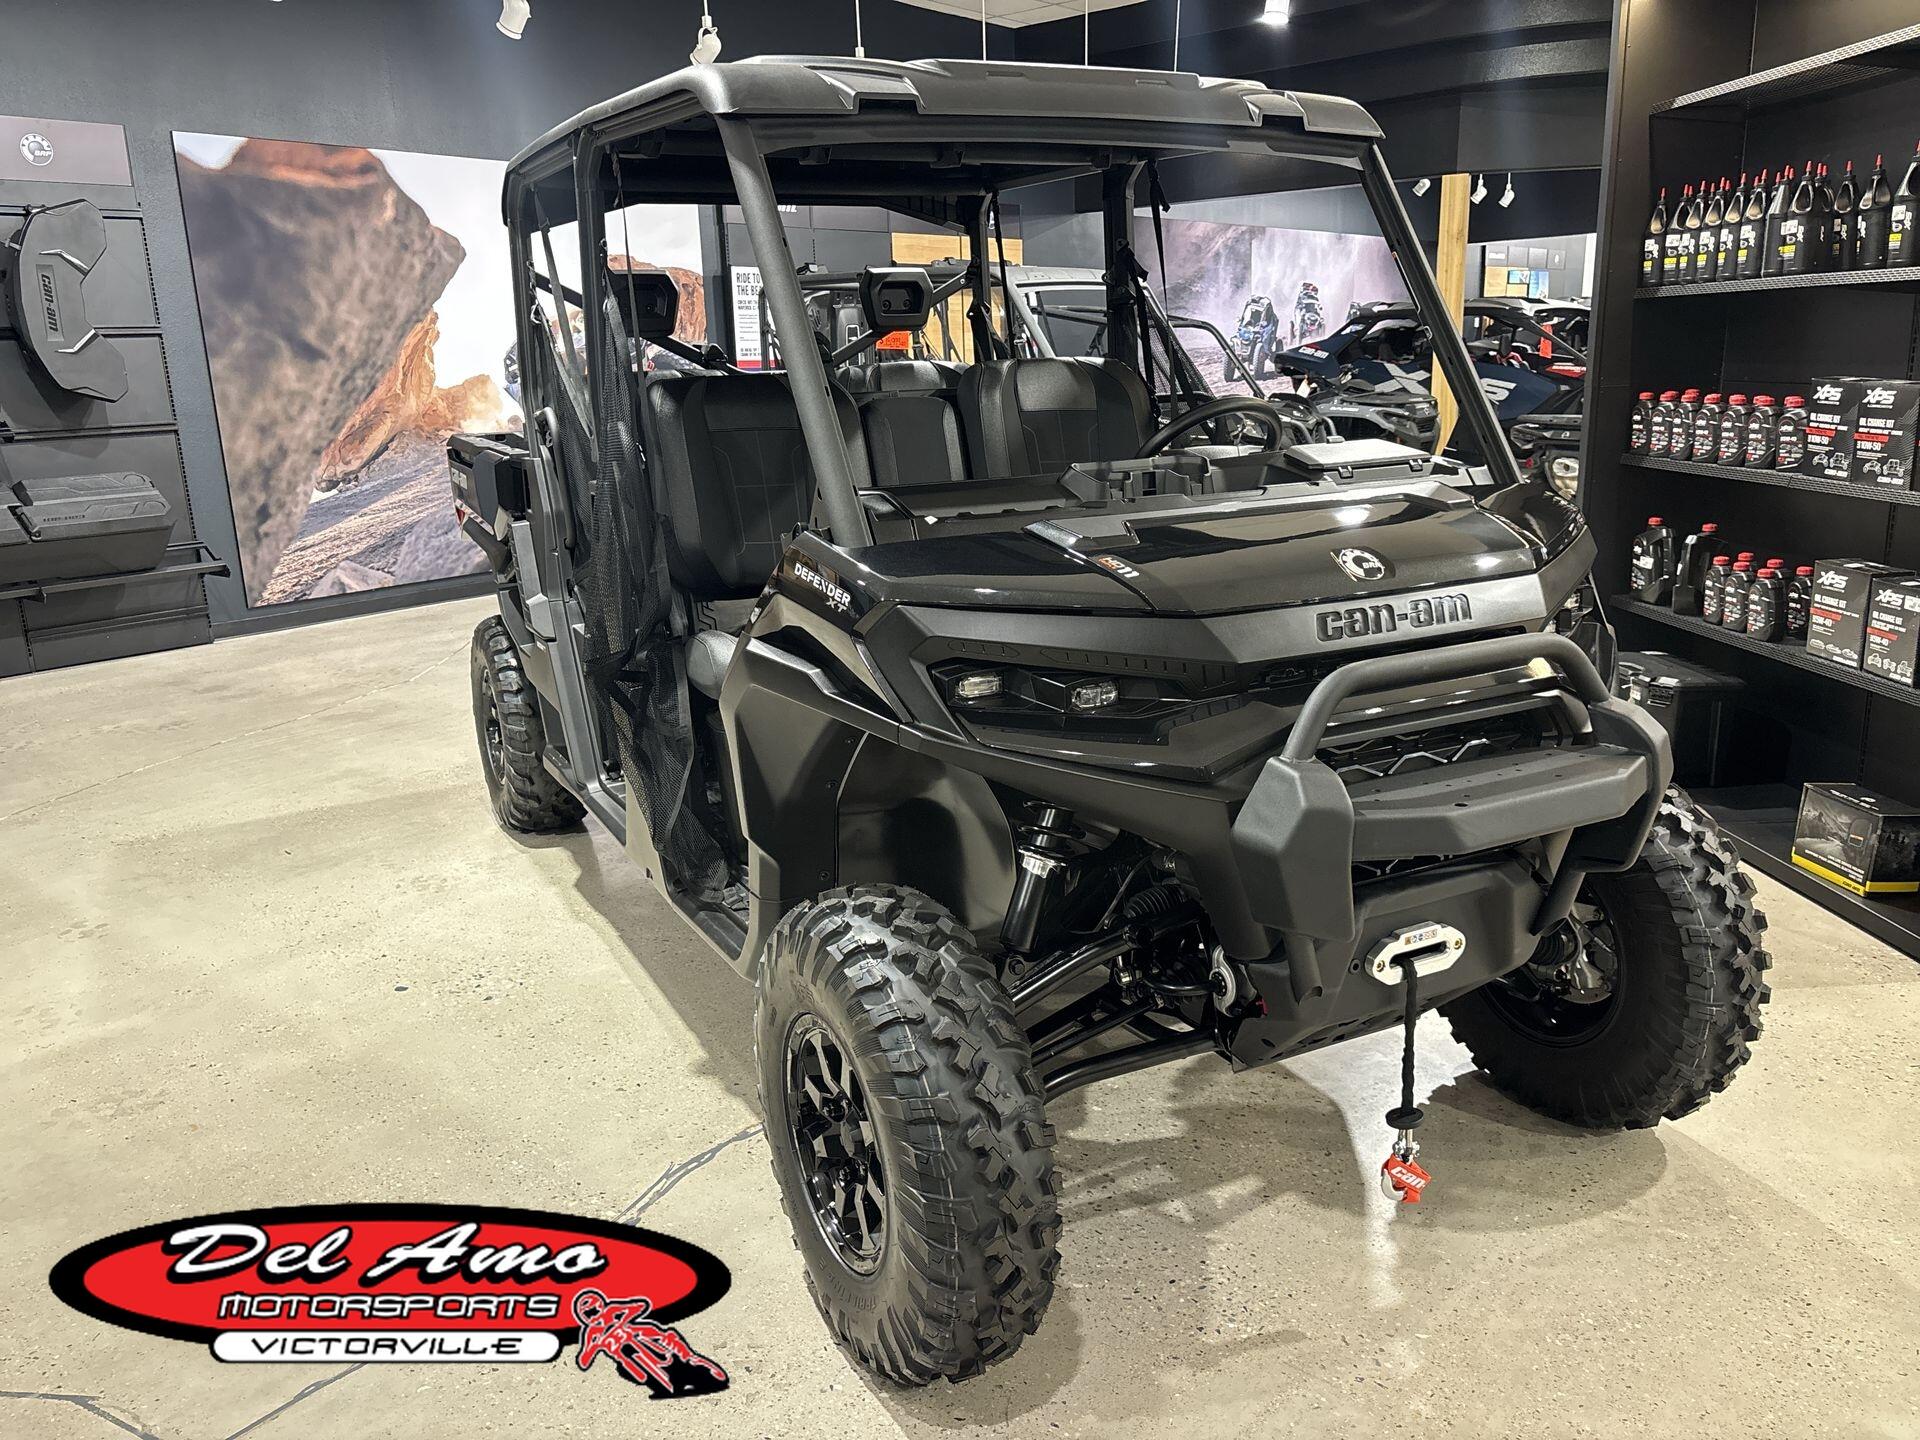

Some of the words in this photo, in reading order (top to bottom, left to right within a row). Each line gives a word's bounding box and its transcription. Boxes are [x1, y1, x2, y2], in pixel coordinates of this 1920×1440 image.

[34, 149, 52, 158] BRP
[736, 272, 752, 284] RIDE
[736, 284, 750, 296] THE
[41, 273, 60, 333] can-am
[1813, 384, 1844, 401] XPS
[1862, 387, 1898, 405] XPS
[1867, 418, 1885, 428] CHANGE
[794, 562, 851, 607] DEFENDER
[1816, 570, 1849, 589] XPS
[825, 598, 848, 612] XT
[1875, 589, 1905, 606] XPS
[1315, 593, 1473, 642] can-am
